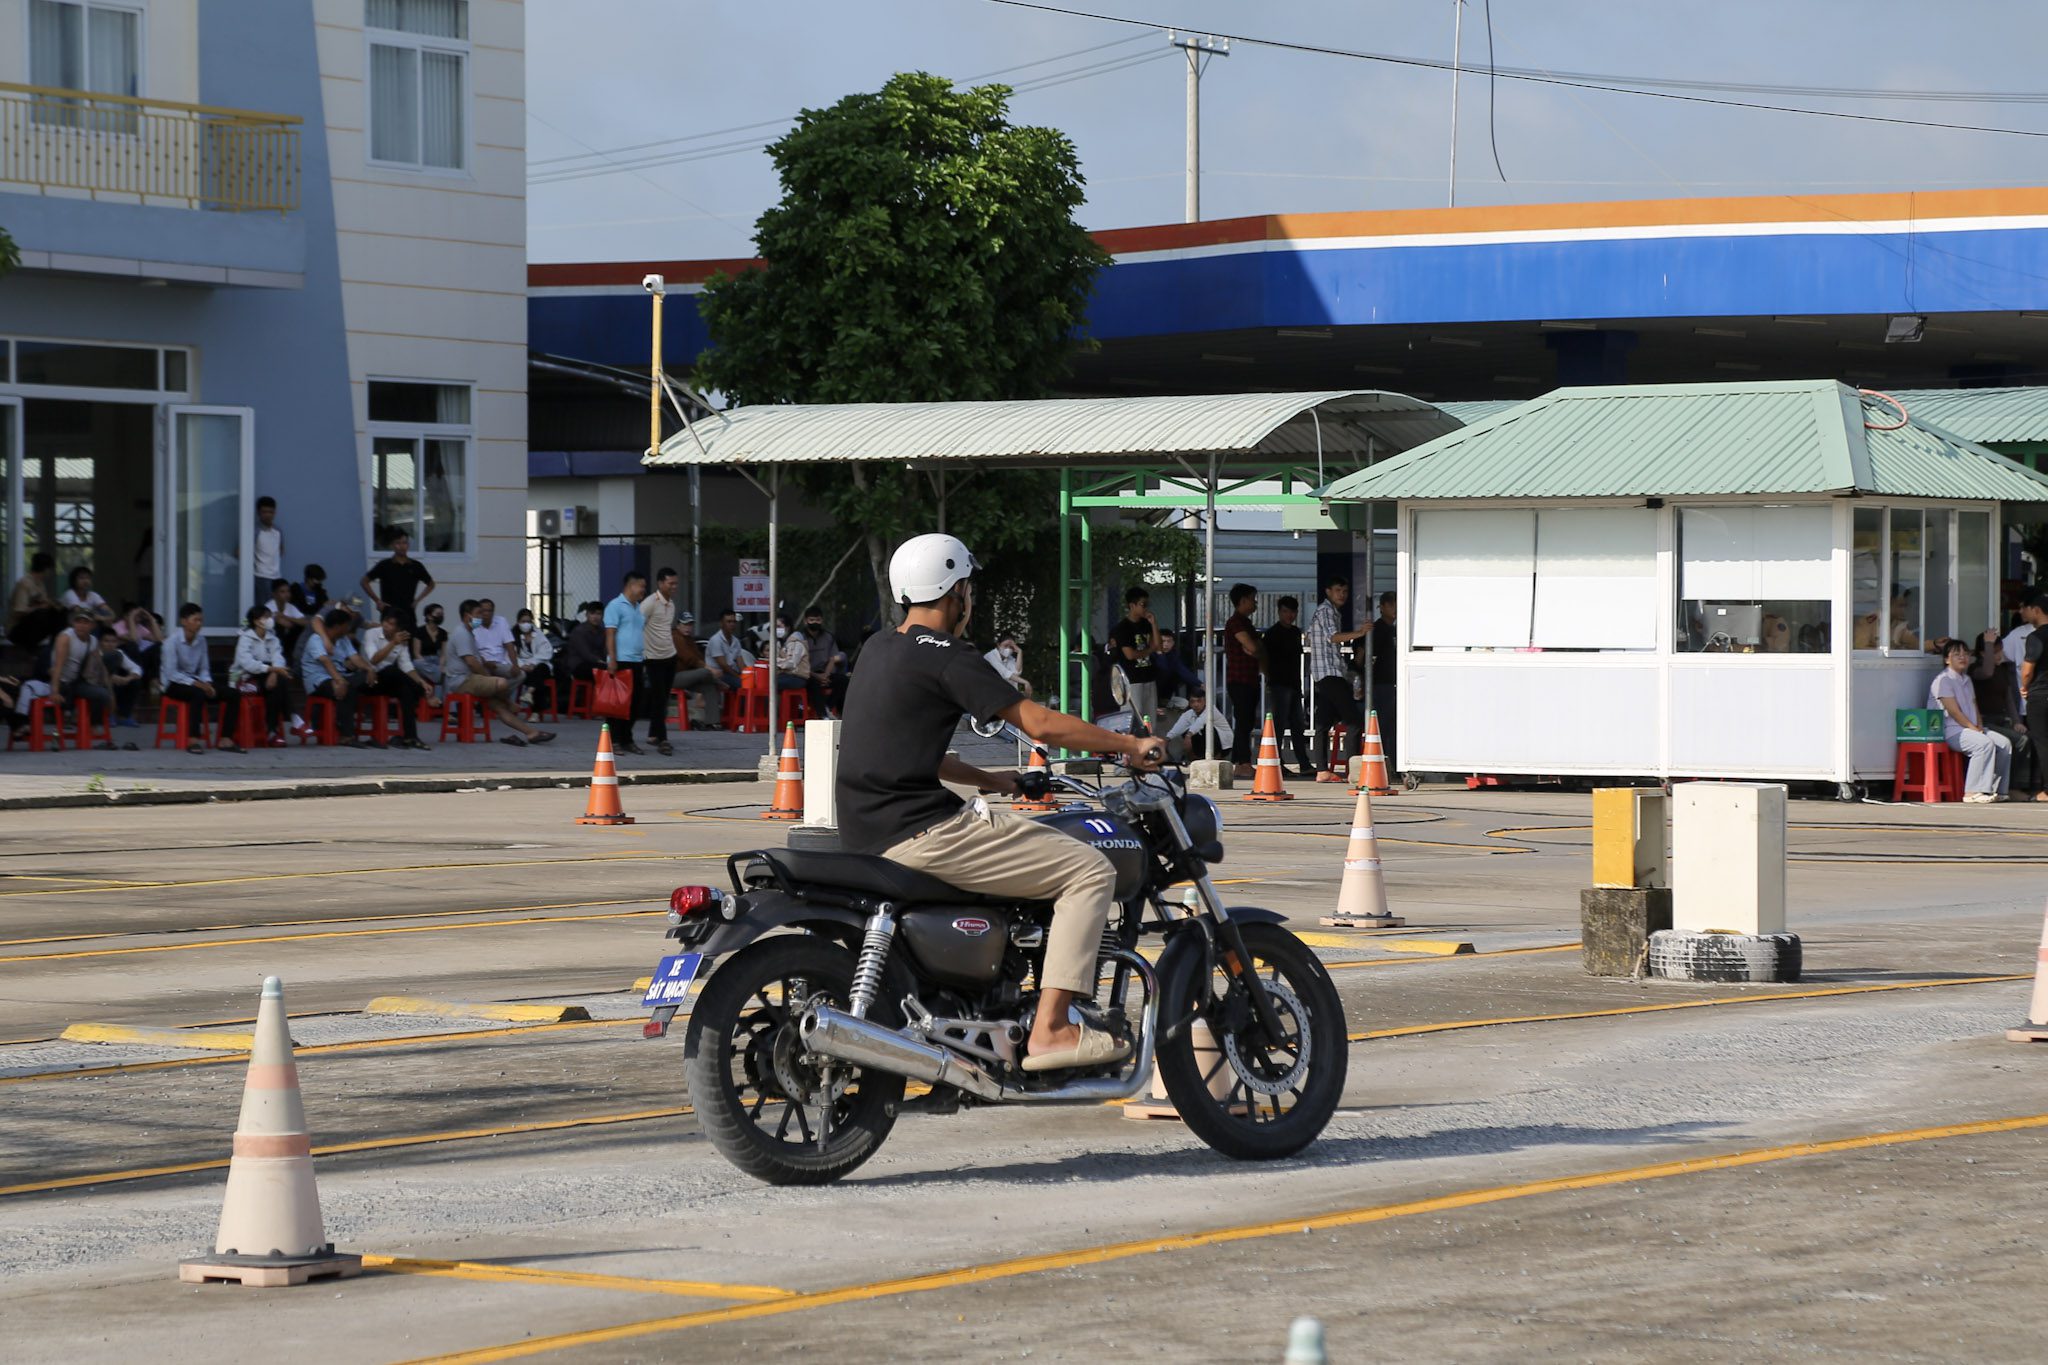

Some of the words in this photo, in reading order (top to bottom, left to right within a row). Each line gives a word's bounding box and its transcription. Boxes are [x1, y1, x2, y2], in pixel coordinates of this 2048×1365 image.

[1085, 819, 1113, 833] 11
[1088, 840, 1142, 849] HONDA
[668, 959, 685, 977] XE
[645, 978, 666, 1000] SÁT
[662, 980, 689, 1002] HẠCH
